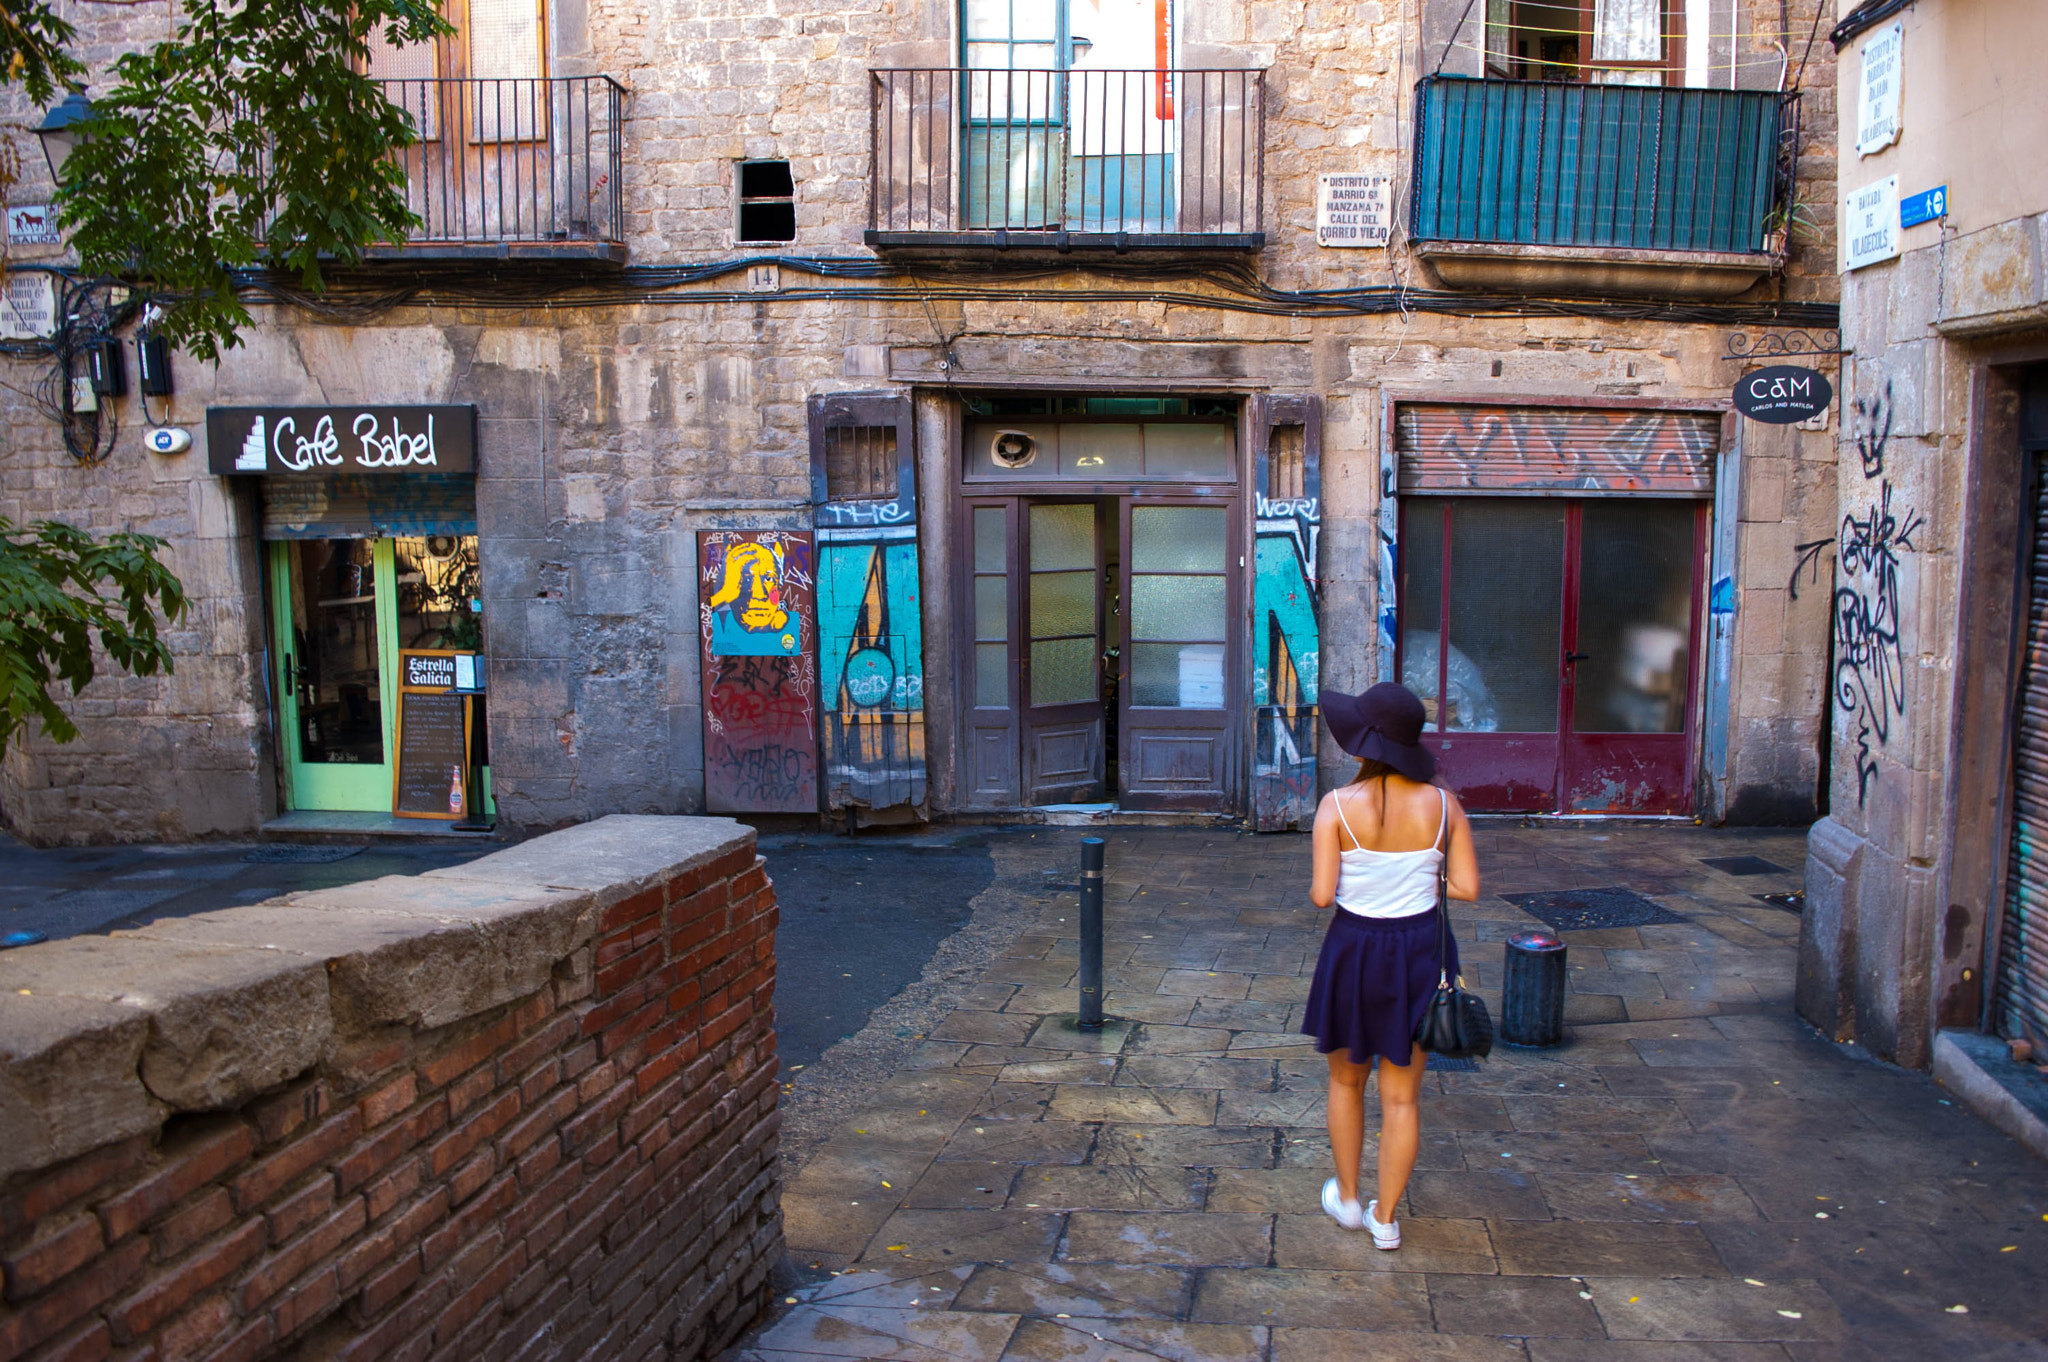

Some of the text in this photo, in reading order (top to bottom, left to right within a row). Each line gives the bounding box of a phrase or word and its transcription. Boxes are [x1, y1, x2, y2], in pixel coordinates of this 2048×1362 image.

[1867, 61, 1886, 84] BARRIO
[1874, 102, 1882, 119] DE
[1329, 177, 1369, 187] DISTRITO
[1332, 190, 1365, 199] BARRIO
[1858, 189, 1881, 210] BAIXADA
[1326, 202, 1371, 211] MANZANA
[1330, 214, 1379, 224] CALLE DEL
[1866, 213, 1874, 228] DE
[12, 234, 58, 245] SALIDA
[1320, 226, 1387, 239] CORREO VIEJO
[1852, 228, 1888, 257] VILADECOLS
[754, 266, 773, 285] 14
[1750, 376, 1810, 399] C&M
[1751, 403, 1773, 412] CARLOS
[1790, 402, 1814, 410] MATILDA
[273, 412, 438, 471] Café Babel
[409, 658, 454, 672] Estrella
[409, 671, 451, 685] Galicia
